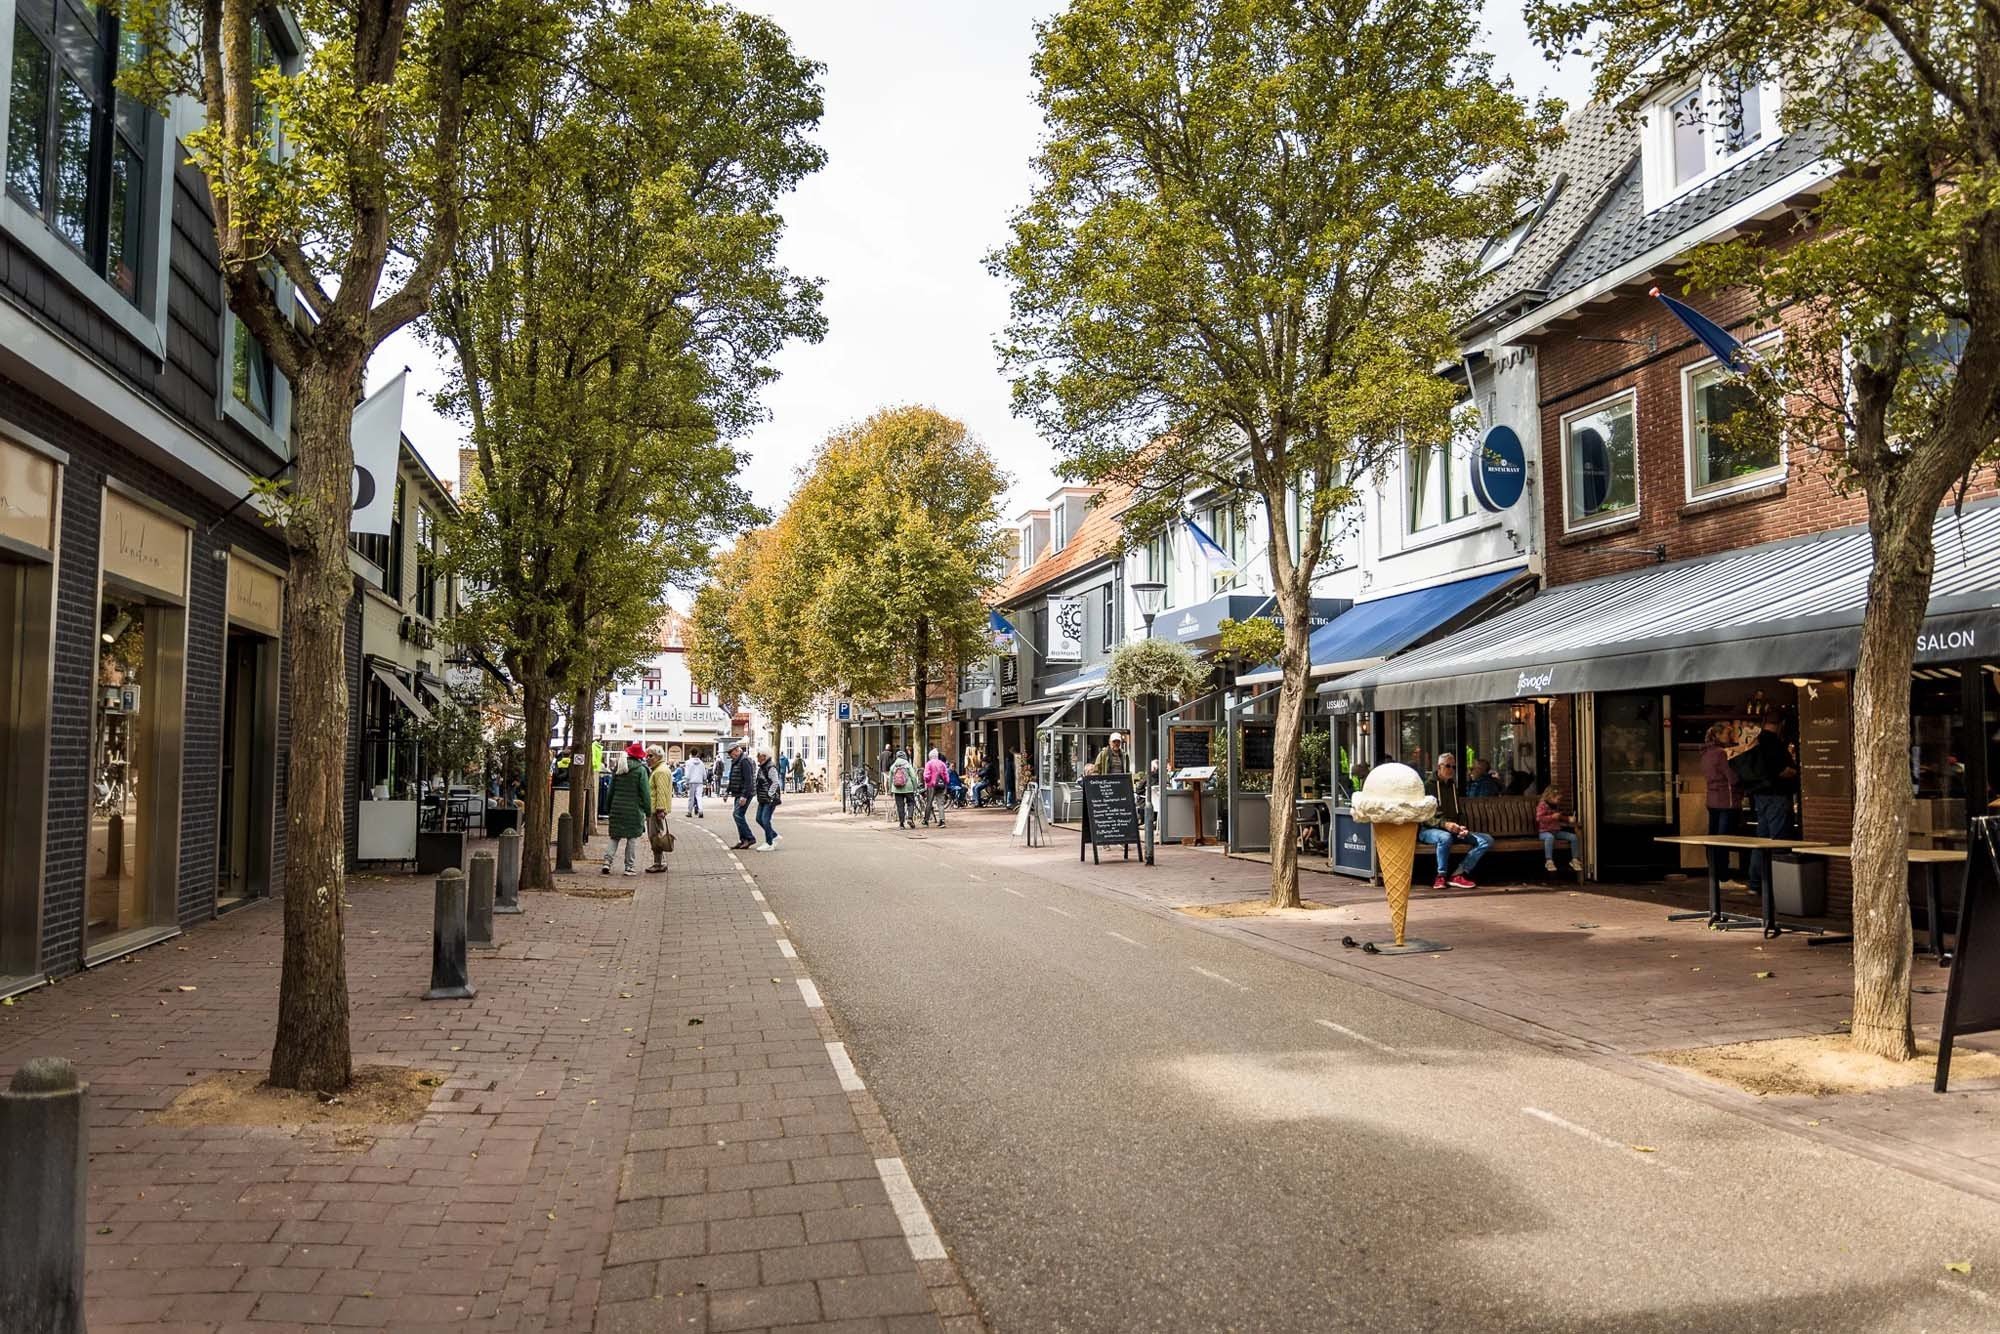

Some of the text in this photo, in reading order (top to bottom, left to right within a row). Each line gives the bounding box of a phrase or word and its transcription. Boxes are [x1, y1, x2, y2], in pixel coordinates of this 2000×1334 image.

[1917, 630, 1974, 652] SALON
[1516, 667, 1554, 696] ijsvogel
[632, 710, 720, 721] DE ROODE LEEUW
[841, 703, 849, 713] P
